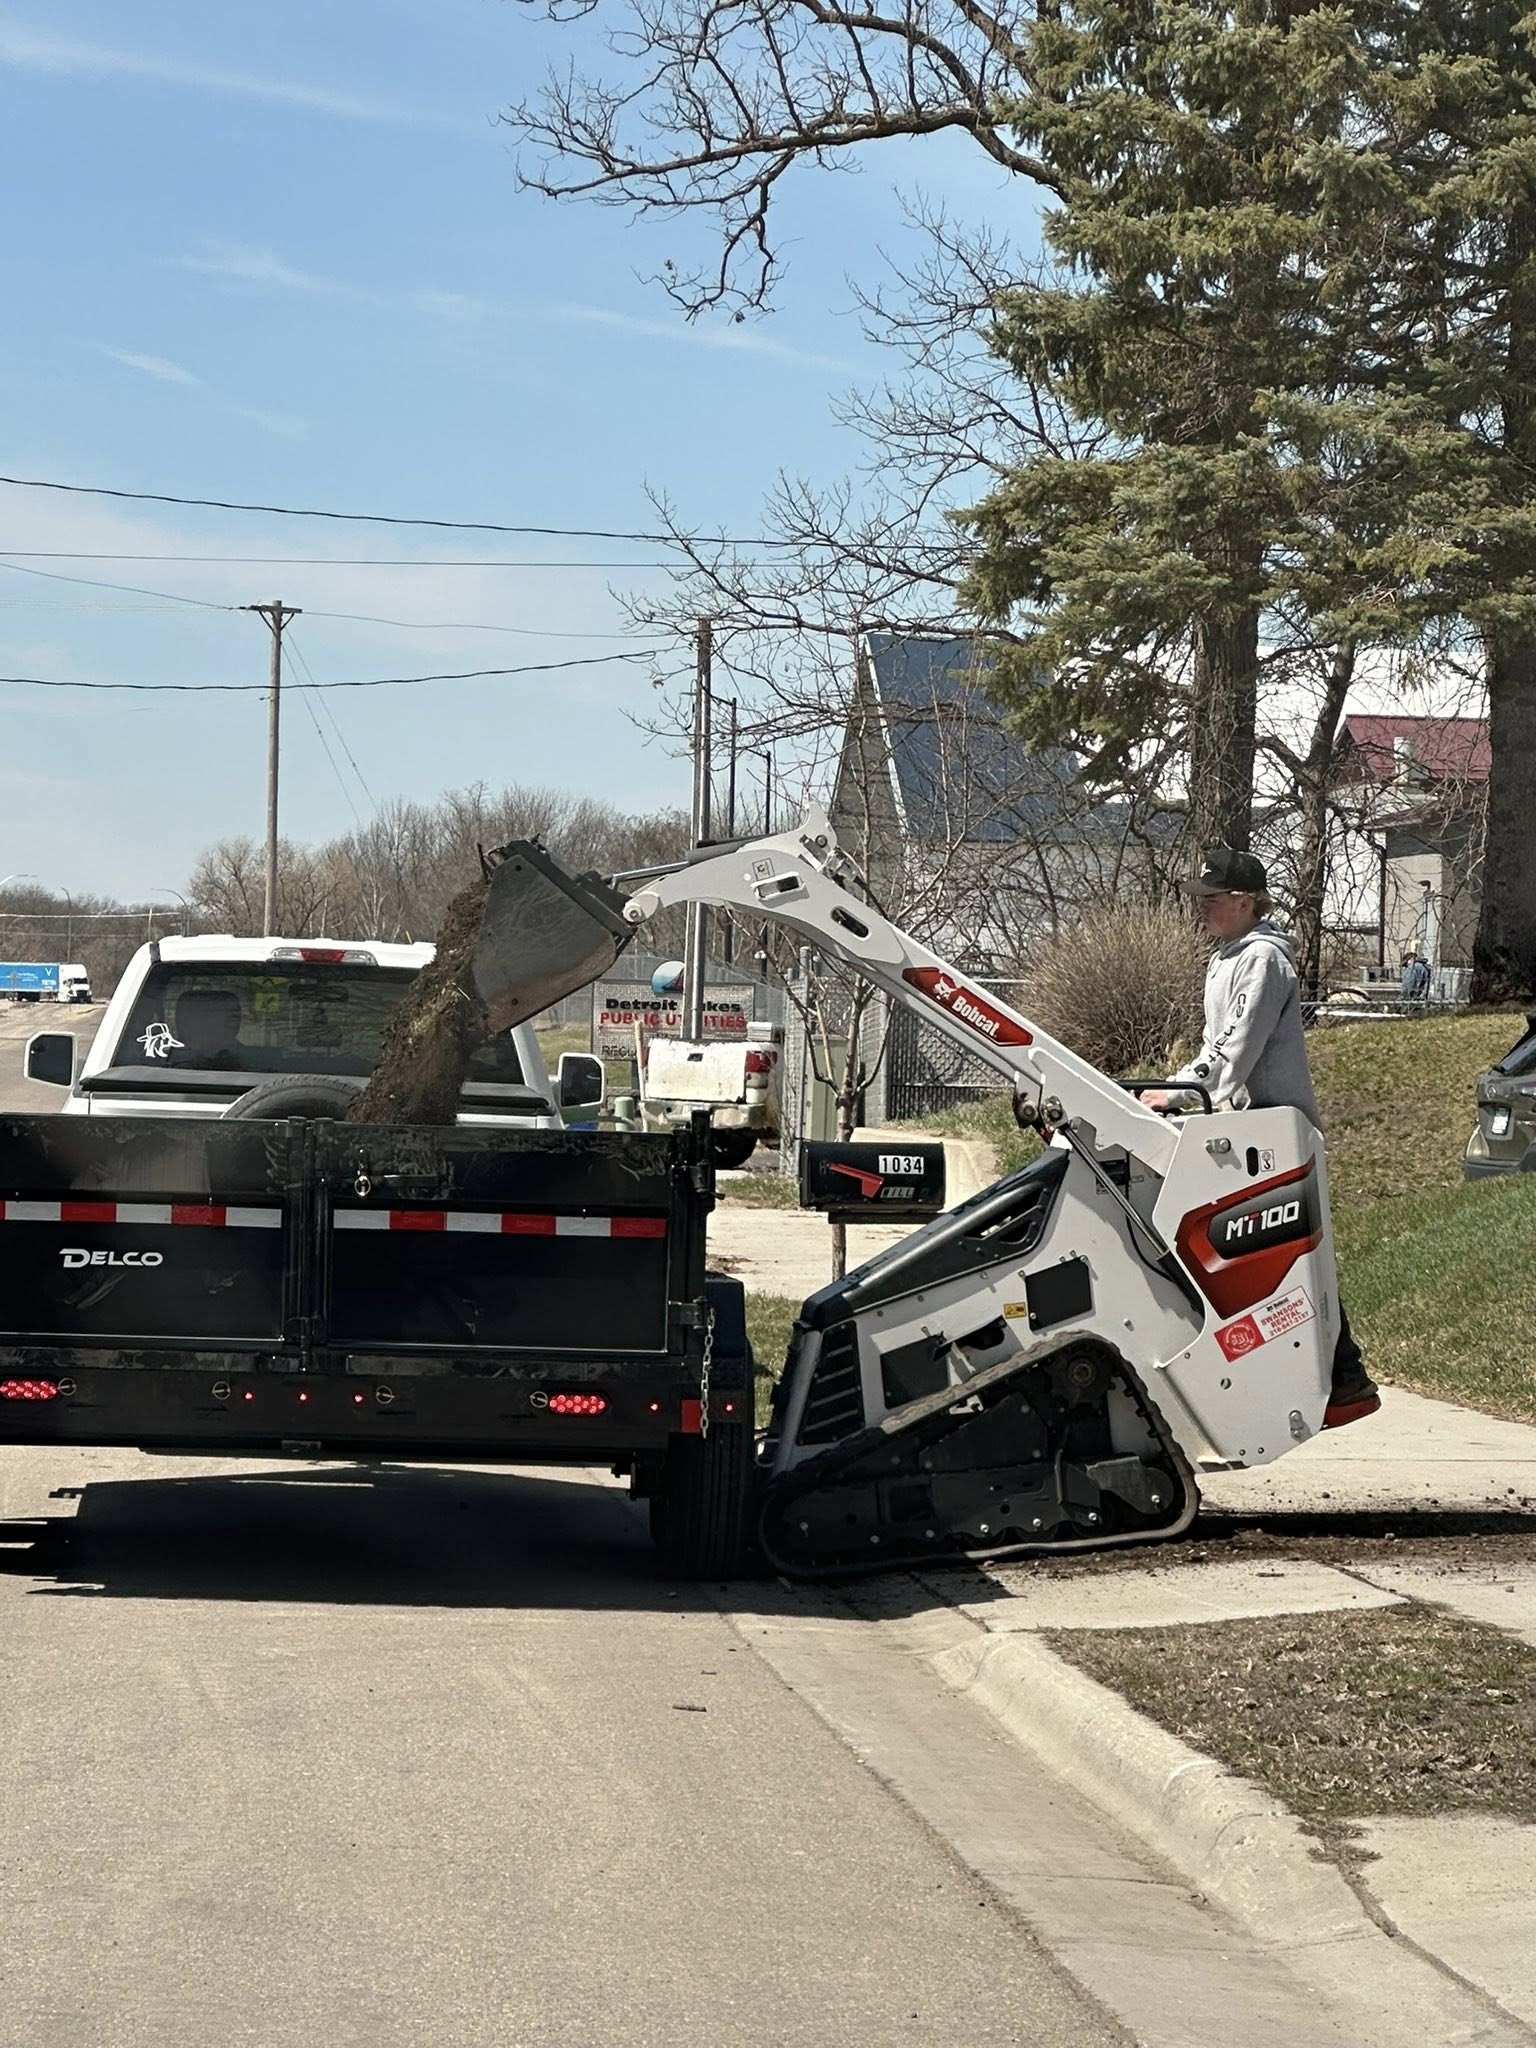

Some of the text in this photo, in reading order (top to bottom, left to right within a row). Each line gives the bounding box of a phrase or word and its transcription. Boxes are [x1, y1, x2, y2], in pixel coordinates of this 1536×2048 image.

[606, 998, 678, 1011] Detroit
[666, 1014, 745, 1027] UITIES
[952, 996, 1000, 1036] Bobcat
[1208, 993, 1247, 1063] cahartt
[883, 1157, 923, 1173] 1034
[1225, 1201, 1300, 1241] MT100
[59, 1248, 164, 1268] DELCO
[1271, 1309, 1301, 1328] RENTAL
